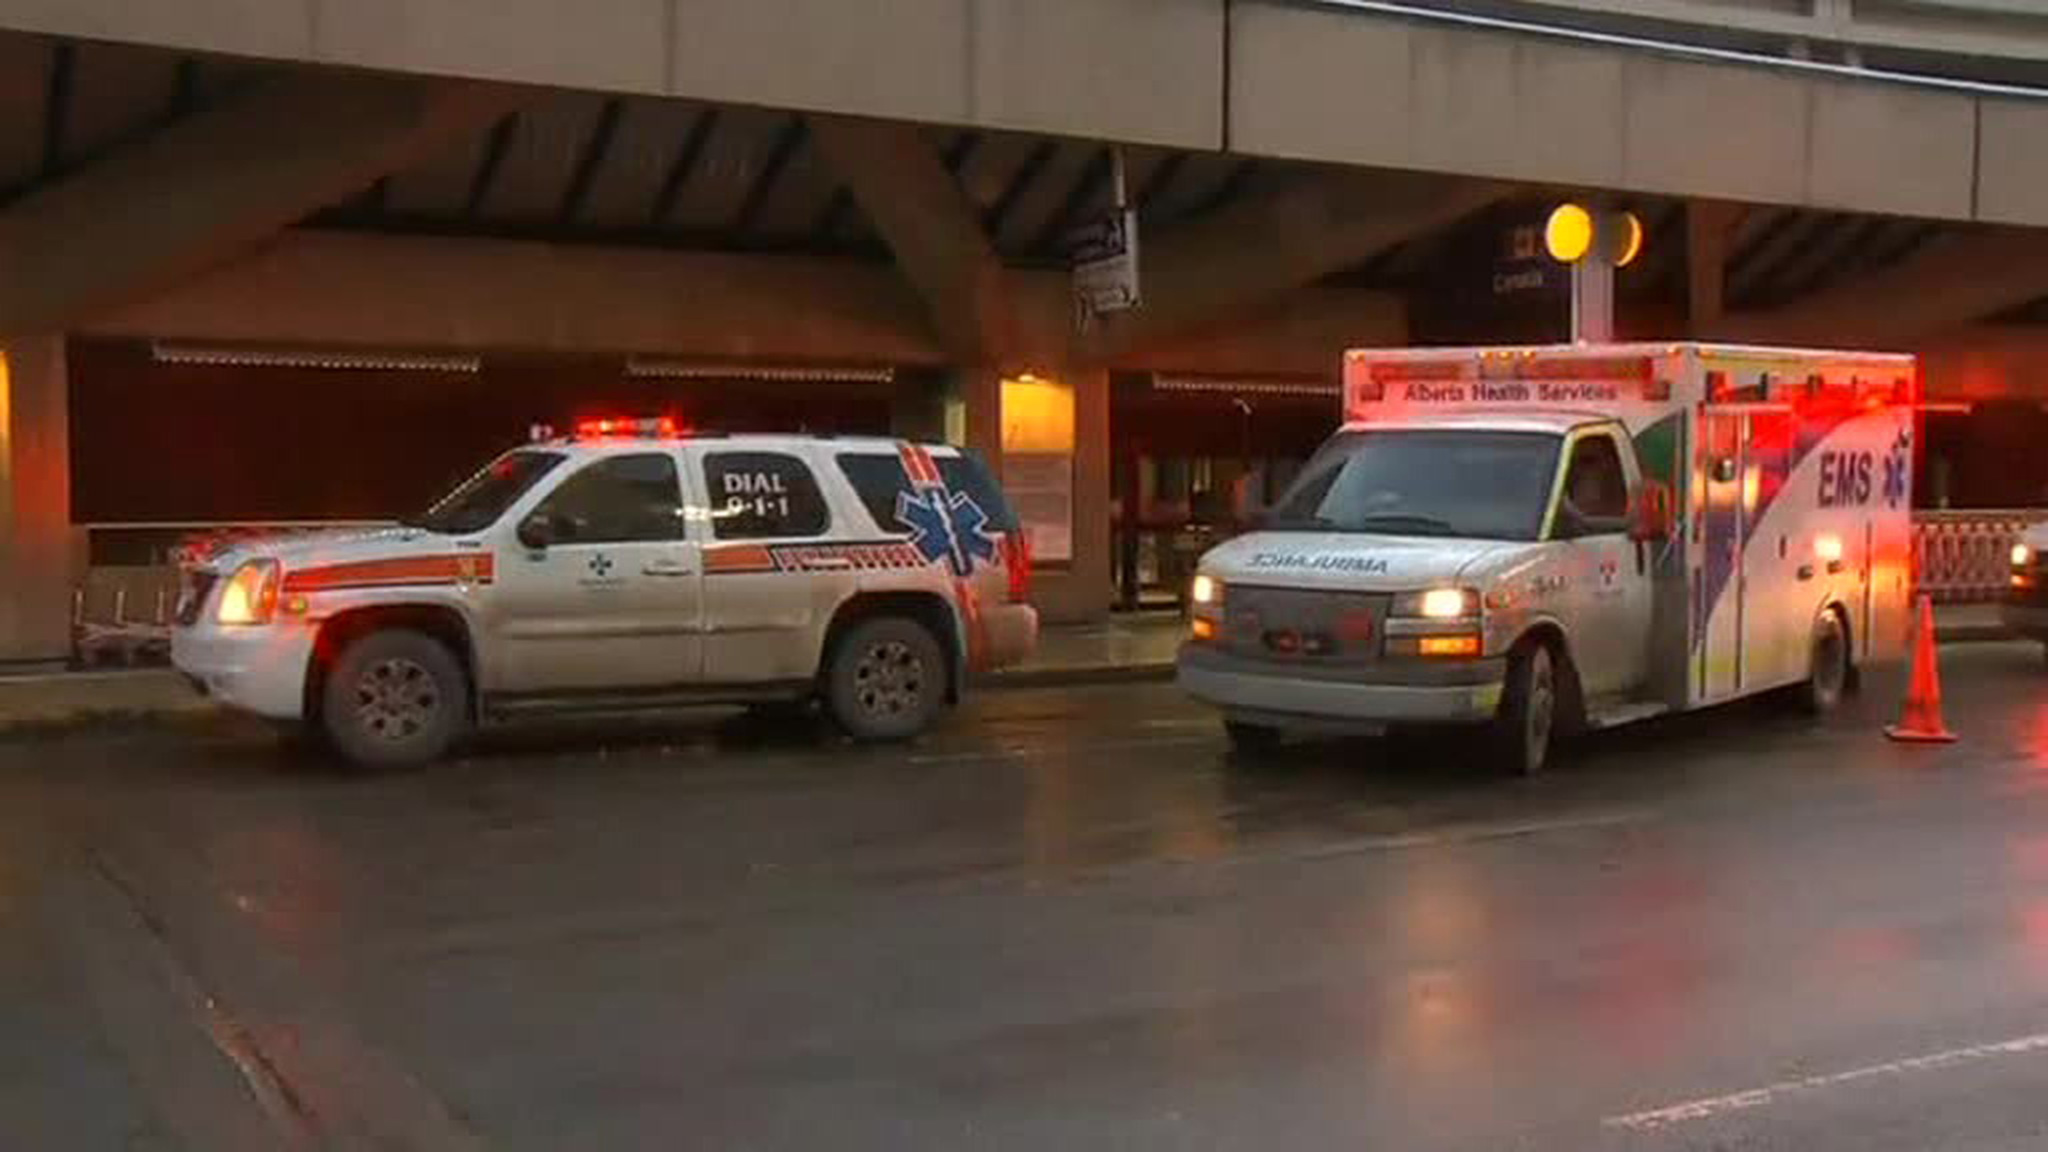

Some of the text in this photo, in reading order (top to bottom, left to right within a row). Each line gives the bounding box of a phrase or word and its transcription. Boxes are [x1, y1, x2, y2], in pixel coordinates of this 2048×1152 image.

[1404, 383, 1617, 401] Alberta Health Services
[724, 472, 787, 493] DIAL
[1818, 450, 1873, 509] EMS
